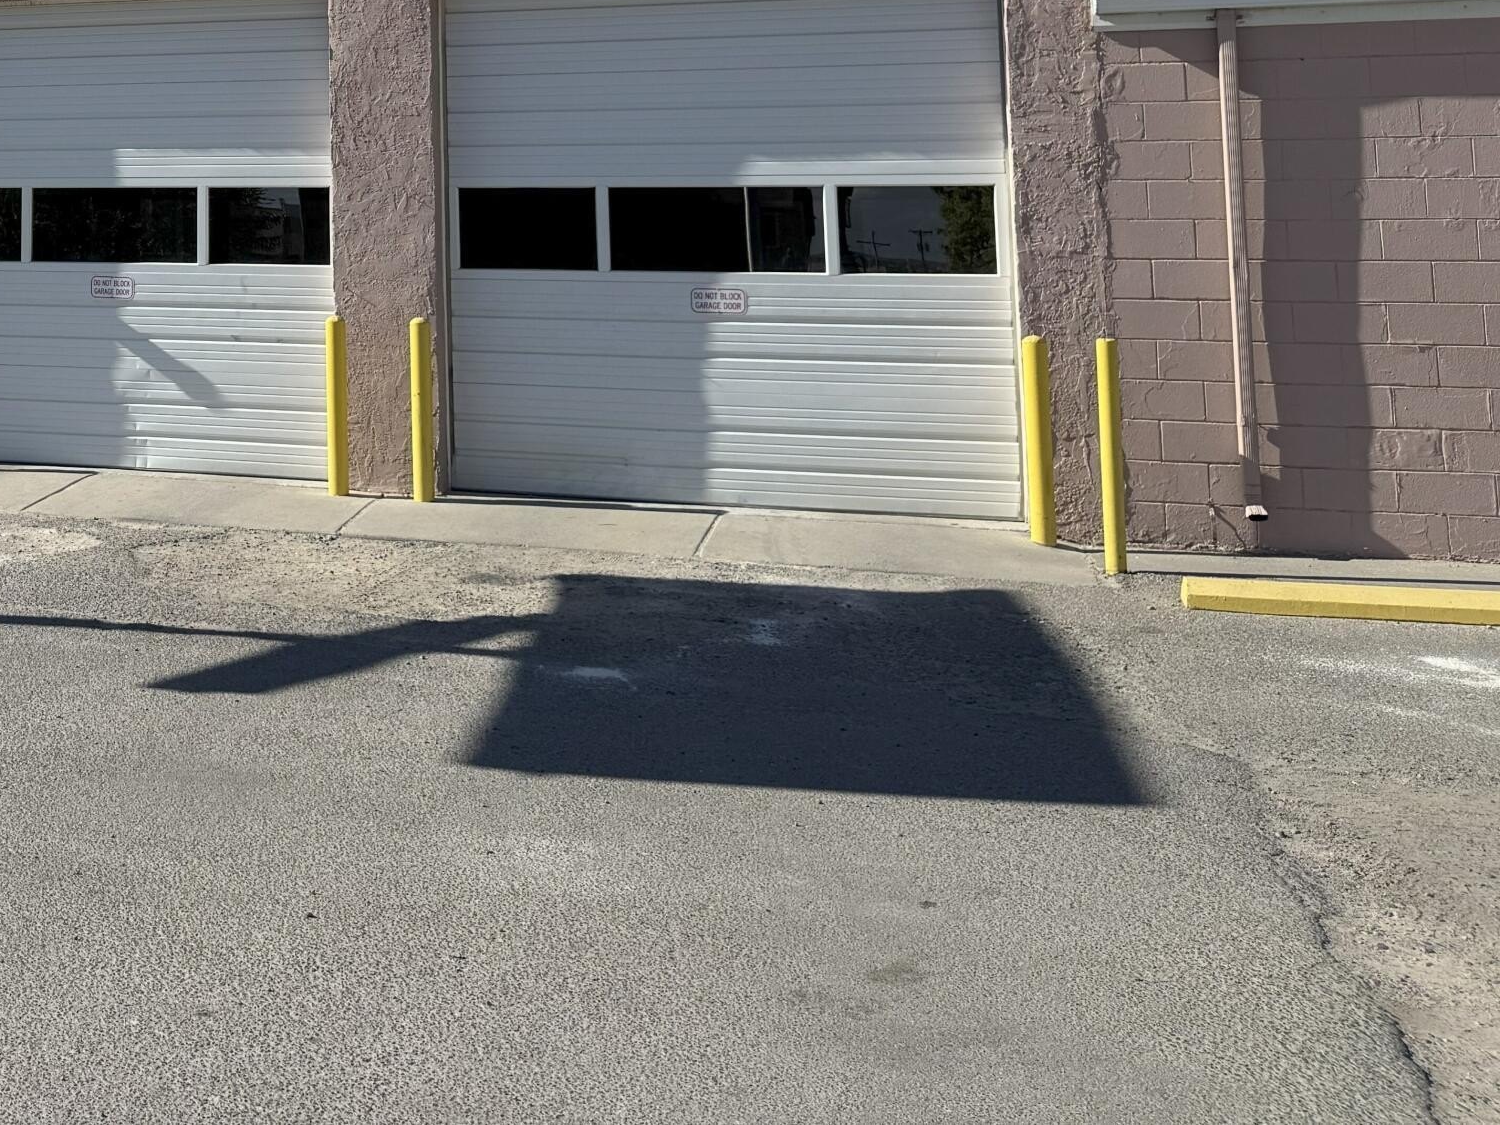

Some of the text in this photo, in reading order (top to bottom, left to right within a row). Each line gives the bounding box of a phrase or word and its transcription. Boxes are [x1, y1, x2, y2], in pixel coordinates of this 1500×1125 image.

[102, 279, 112, 287] NOT
[115, 288, 130, 296] DOOR
[704, 291, 717, 300] NOT
[719, 292, 742, 300] BLOCK
[694, 301, 742, 310] GARAGE DOOR
